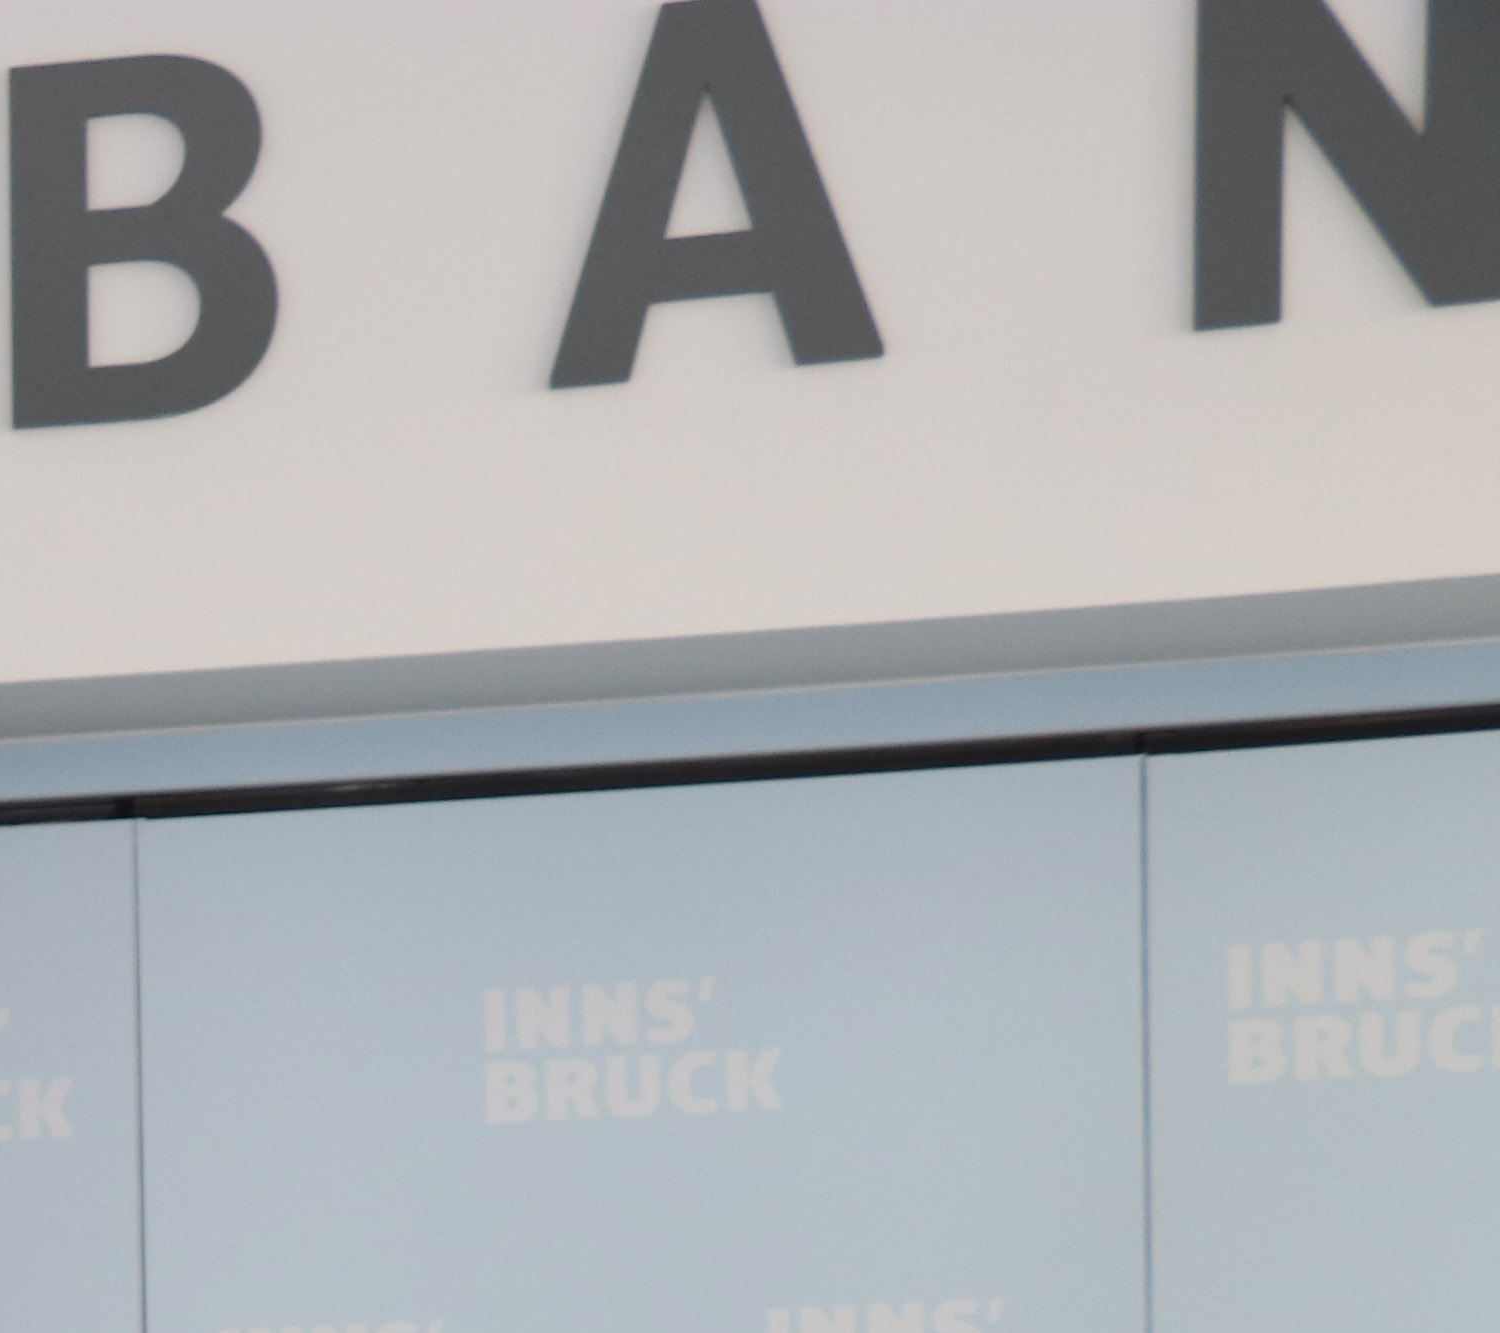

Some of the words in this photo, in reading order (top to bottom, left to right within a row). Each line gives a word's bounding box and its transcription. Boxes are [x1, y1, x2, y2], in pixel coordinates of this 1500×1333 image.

[1224, 926, 1484, 1010] INNS'
[482, 976, 716, 1051] INNS'
[1226, 1005, 1500, 1086] BRUC
[482, 1048, 785, 1125] BRUCK
